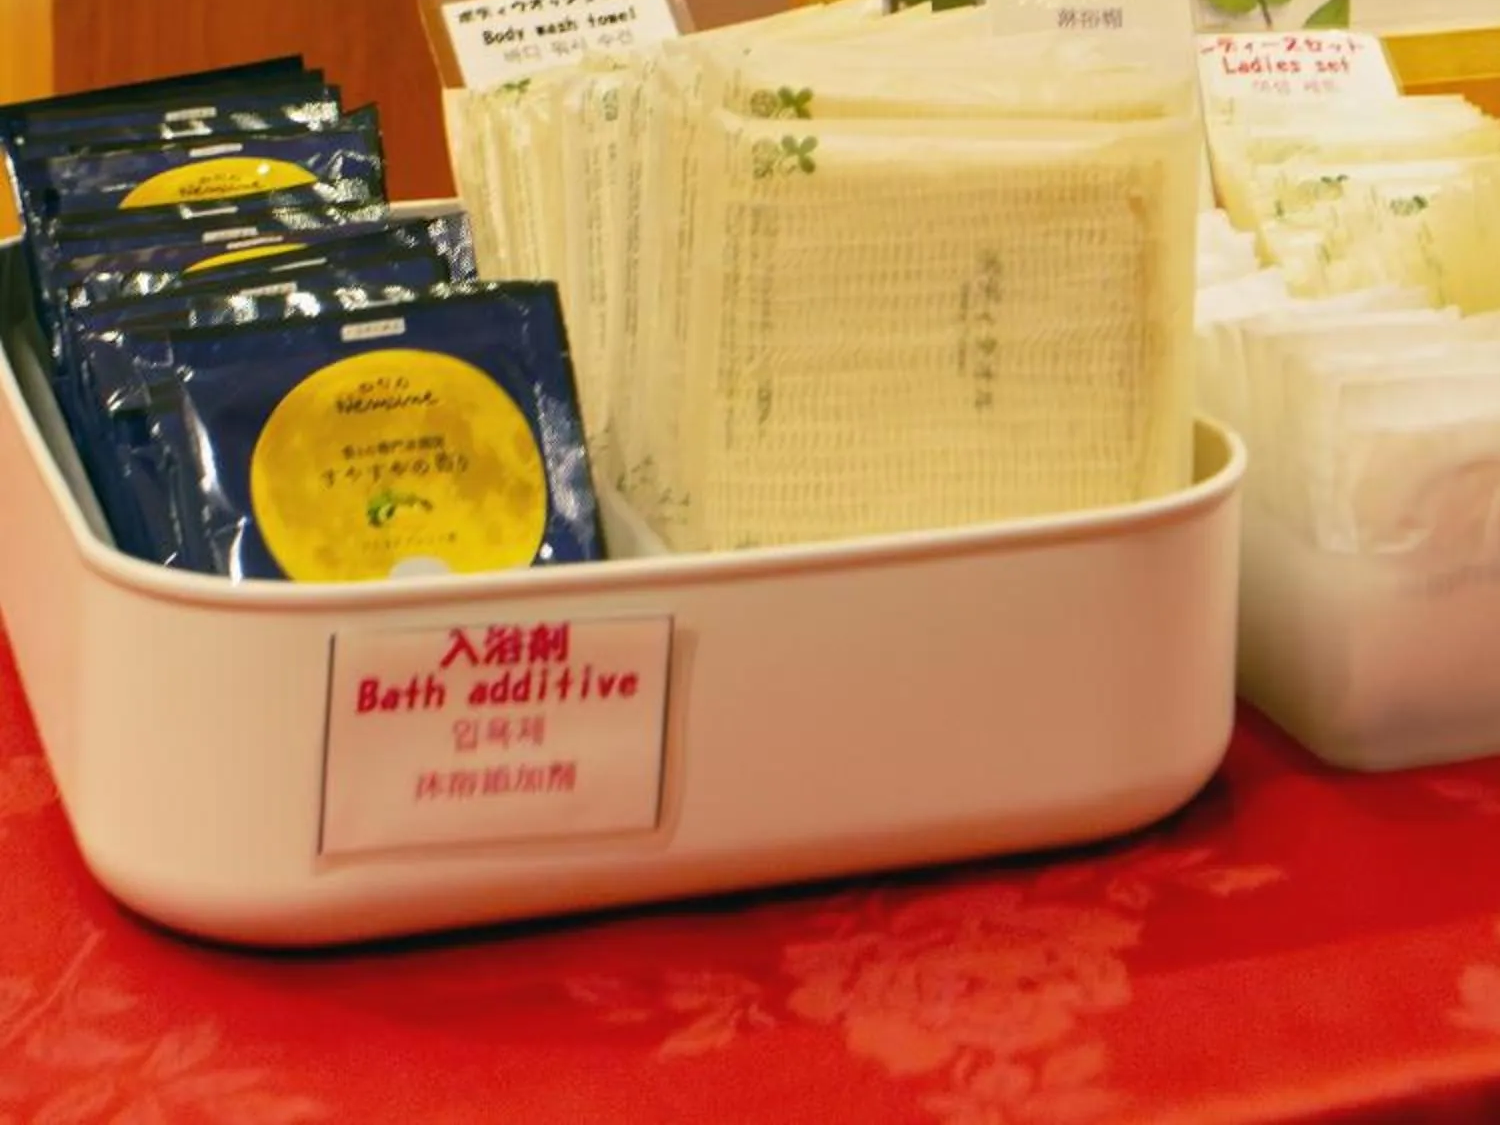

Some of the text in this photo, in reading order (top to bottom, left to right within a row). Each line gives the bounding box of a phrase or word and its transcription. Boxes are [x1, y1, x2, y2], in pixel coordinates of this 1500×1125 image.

[482, 6, 636, 46] Body wash towel
[1223, 57, 1350, 75] Ladies set
[440, 622, 572, 669] 入浴剤
[355, 664, 640, 714] Bath additive
